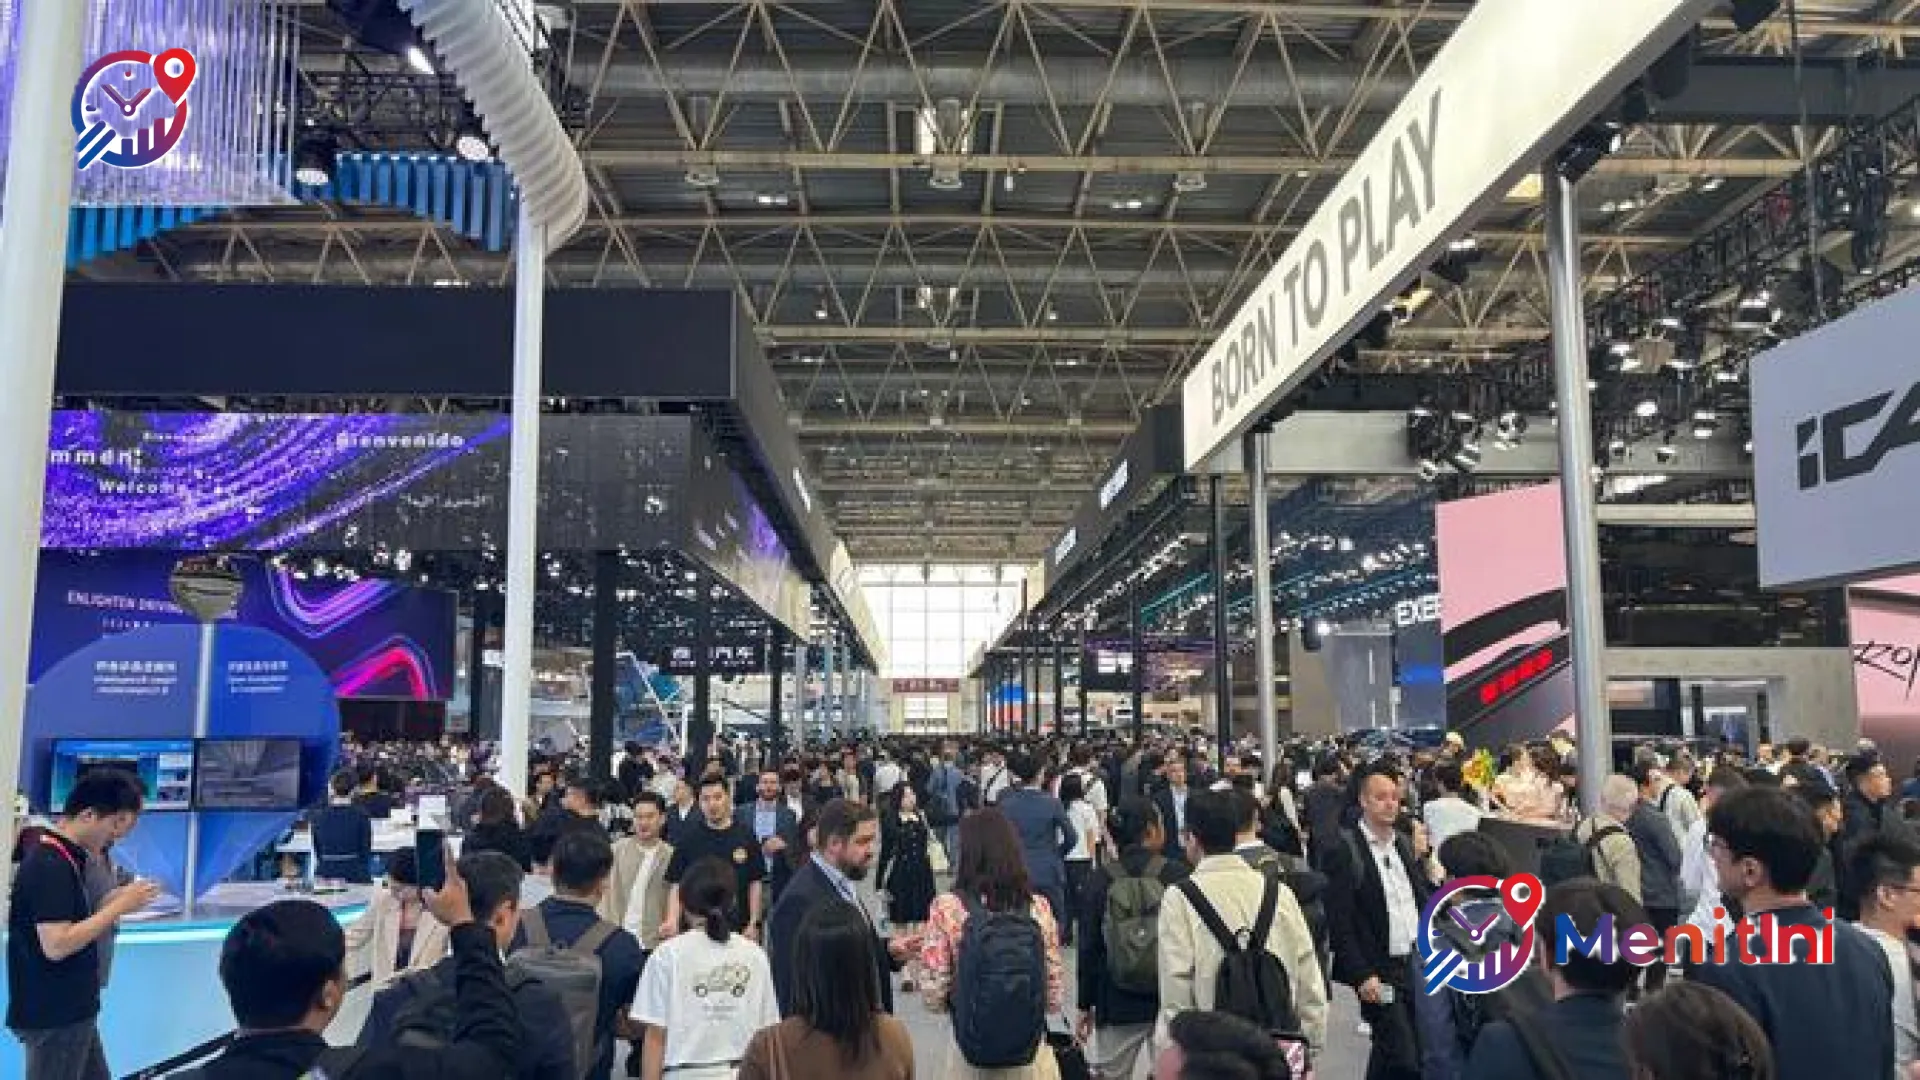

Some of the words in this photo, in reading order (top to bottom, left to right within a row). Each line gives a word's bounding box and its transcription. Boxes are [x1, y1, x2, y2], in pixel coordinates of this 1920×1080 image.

[1211, 291, 1276, 426] BORN
[1283, 238, 1329, 348] TO
[1337, 85, 1443, 297] PLAY
